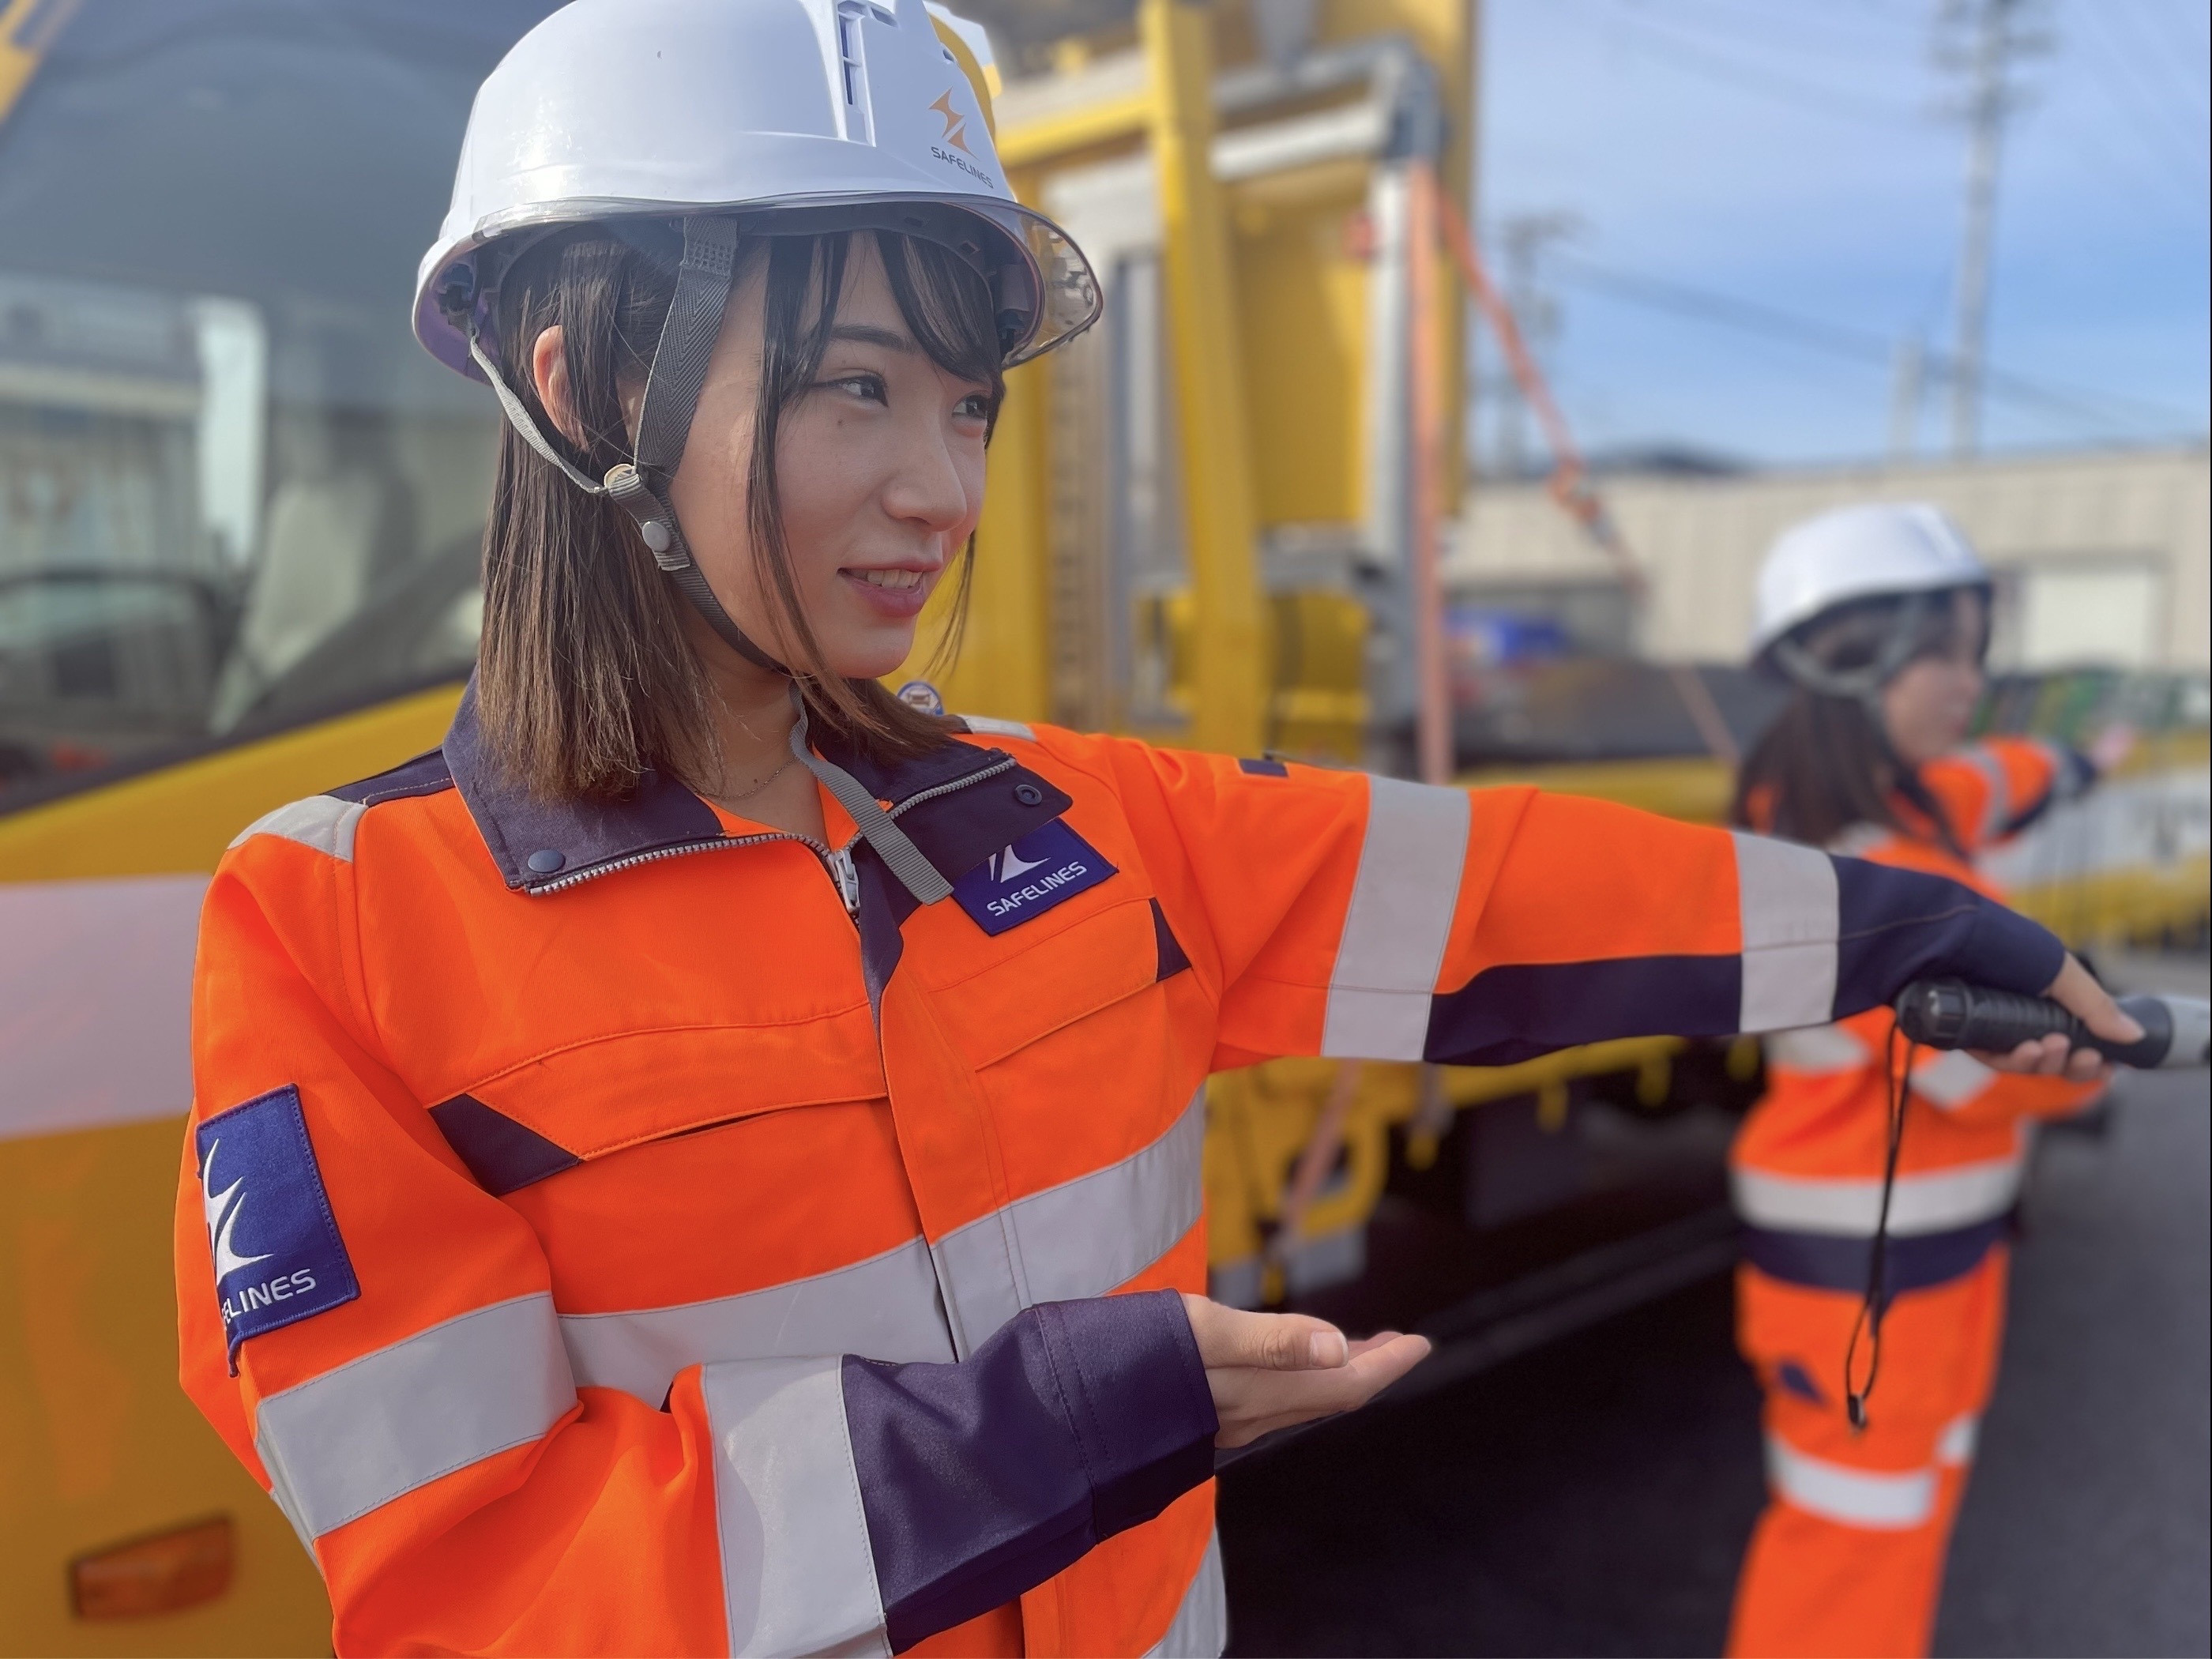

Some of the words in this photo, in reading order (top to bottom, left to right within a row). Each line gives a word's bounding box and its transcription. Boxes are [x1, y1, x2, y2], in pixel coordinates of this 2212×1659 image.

[931, 146, 994, 189] SAFELINES
[987, 861, 1087, 916] SAFELINES
[222, 1268, 316, 1326] ELINES
